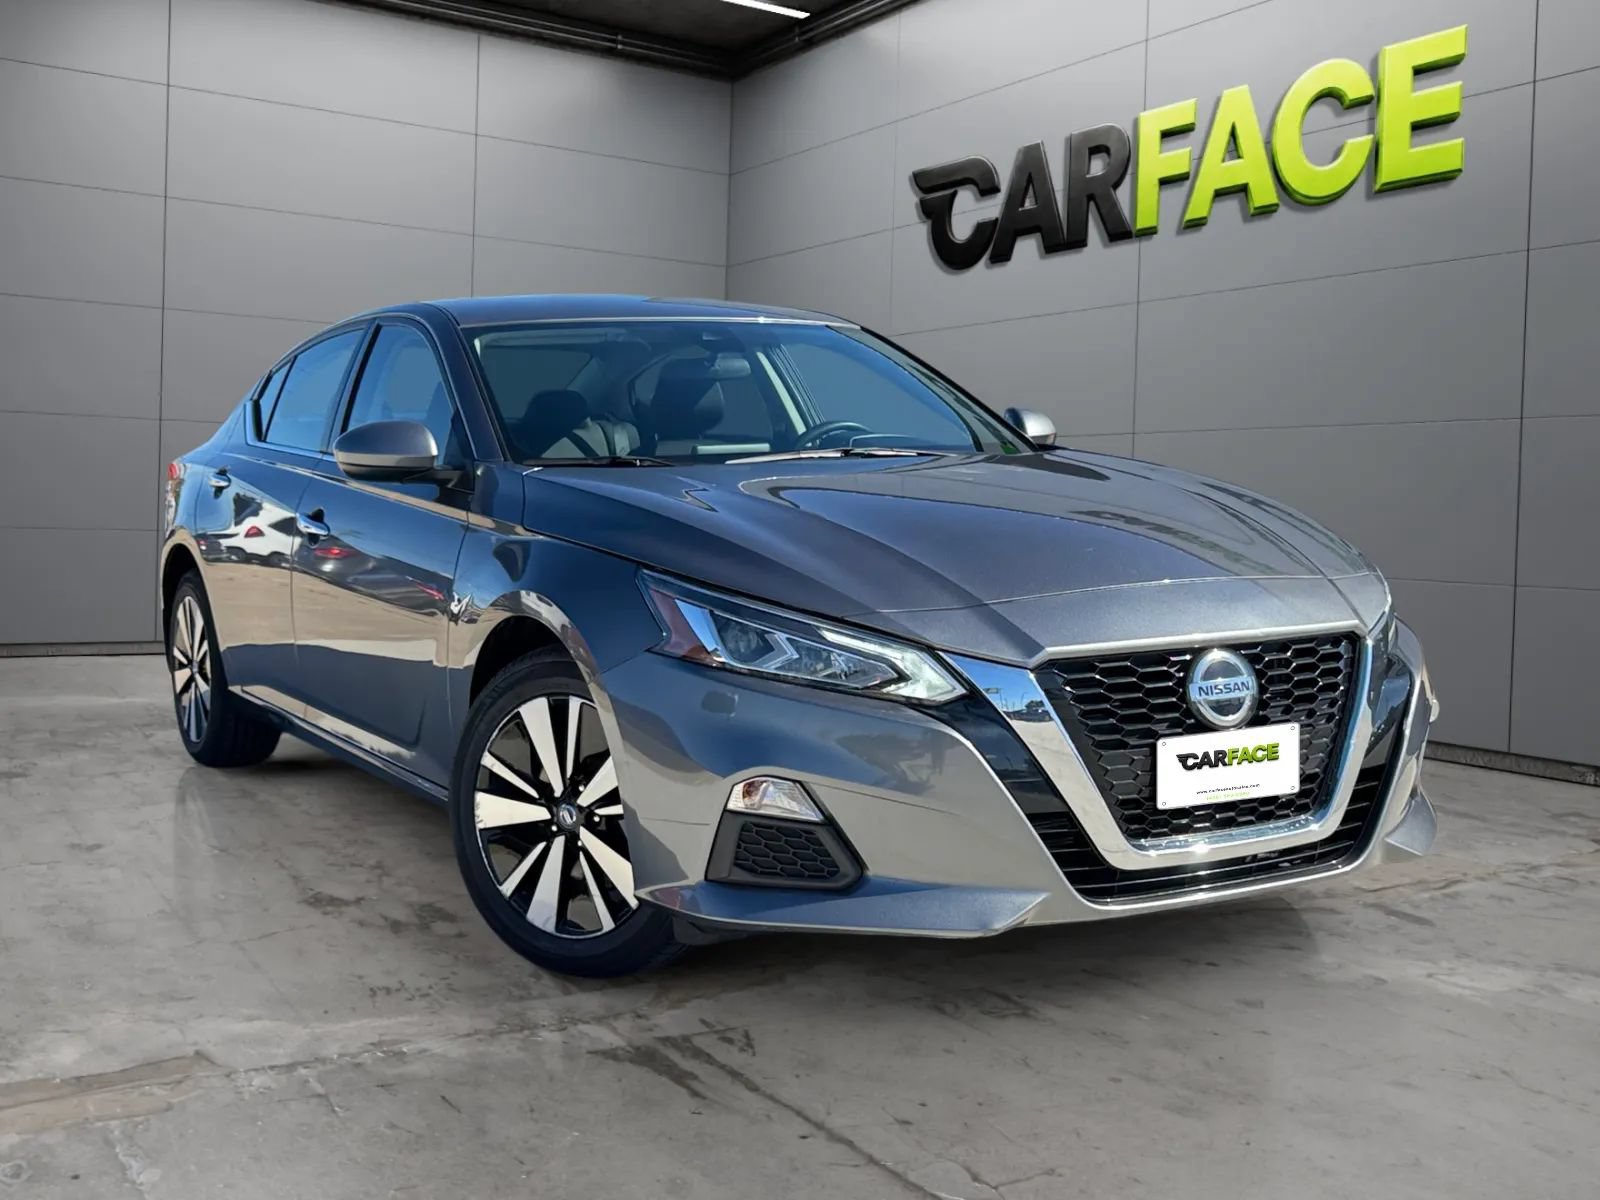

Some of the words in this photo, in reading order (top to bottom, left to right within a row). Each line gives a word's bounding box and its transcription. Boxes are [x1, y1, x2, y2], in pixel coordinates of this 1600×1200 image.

[911, 24, 1468, 270] CARFACE
[1198, 681, 1250, 697] NISSAN
[1176, 743, 1280, 771] CARFACE
